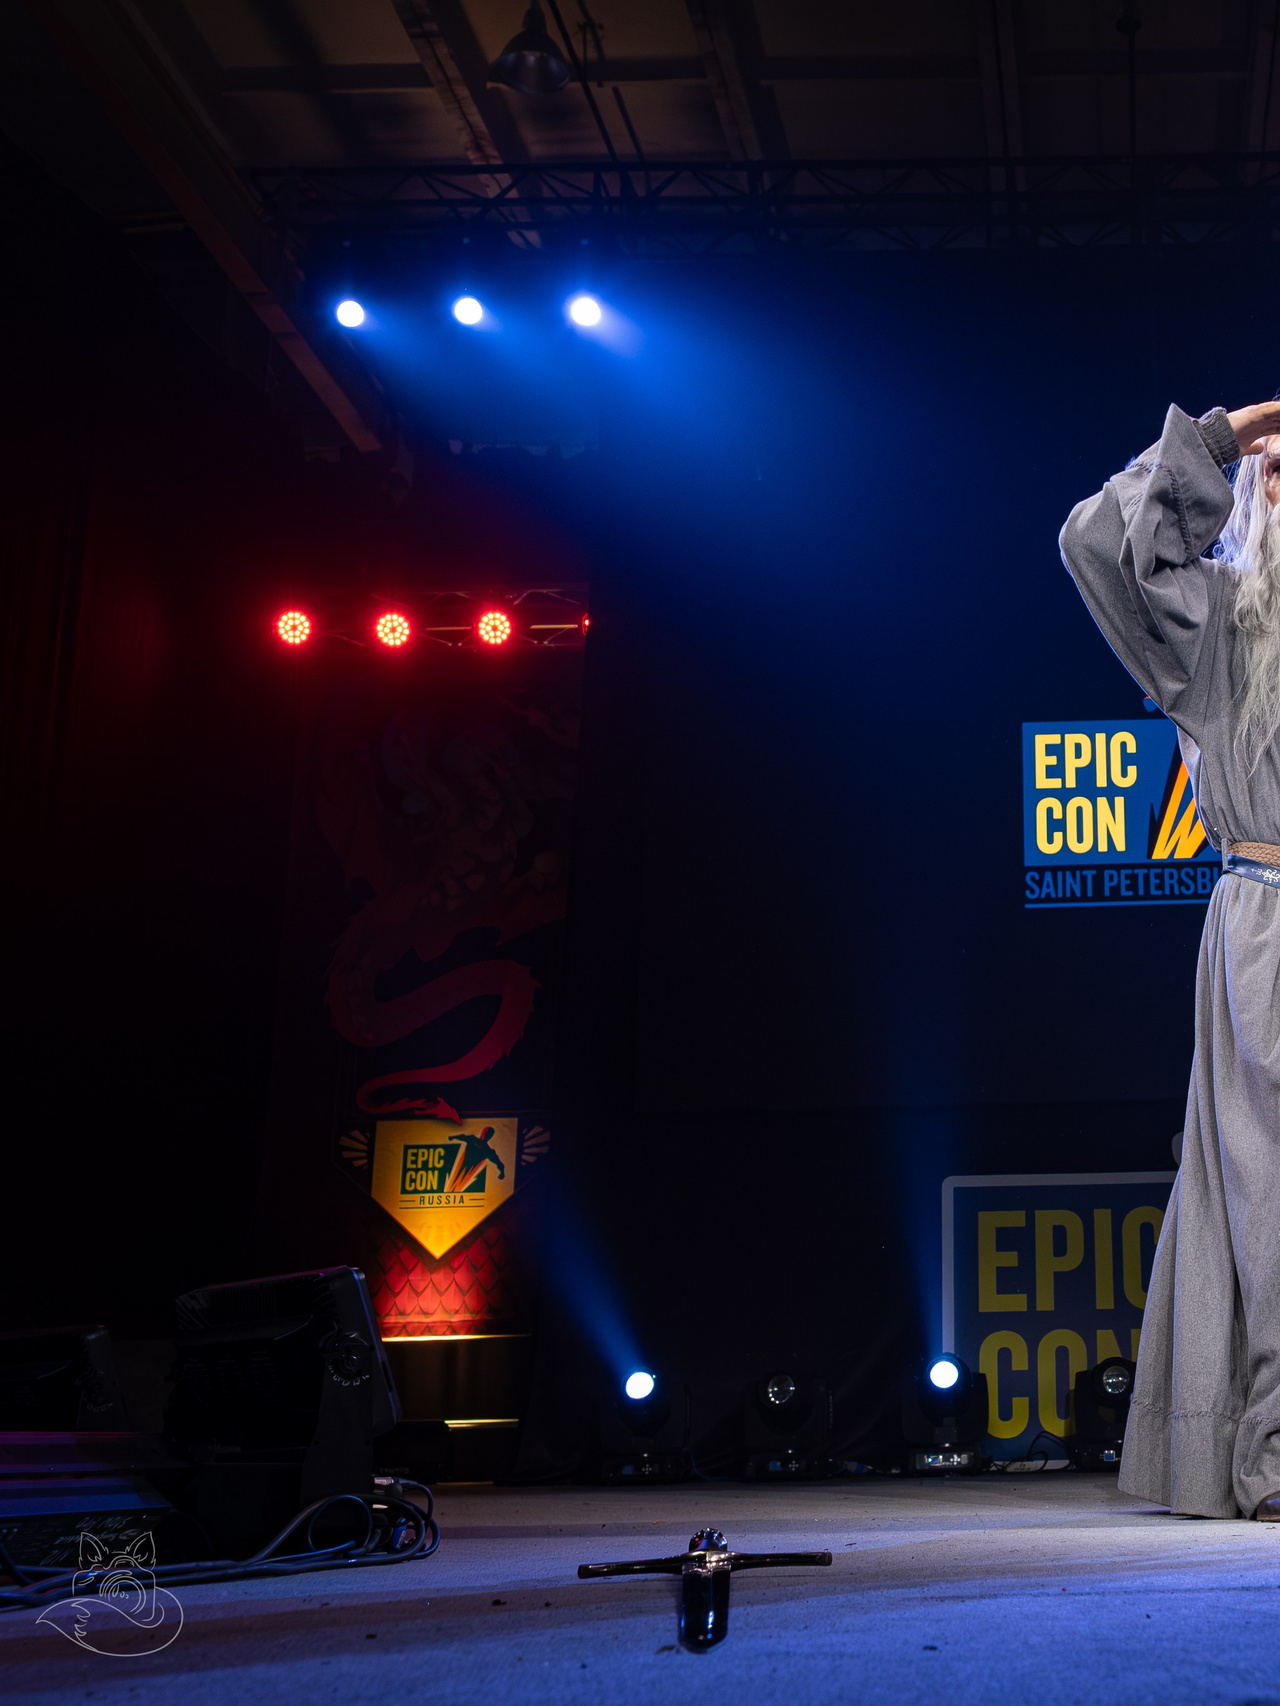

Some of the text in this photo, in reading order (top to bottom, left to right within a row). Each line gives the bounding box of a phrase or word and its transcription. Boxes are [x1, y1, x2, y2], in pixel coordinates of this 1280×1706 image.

[1034, 731, 1137, 789] EPIC
[1036, 796, 1126, 854] CON
[1025, 870, 1097, 899] SAINT
[406, 1147, 445, 1169] EPIC
[404, 1170, 439, 1191] CON
[419, 1194, 465, 1206] RUSSIA
[977, 1206, 1166, 1313] EPIC
